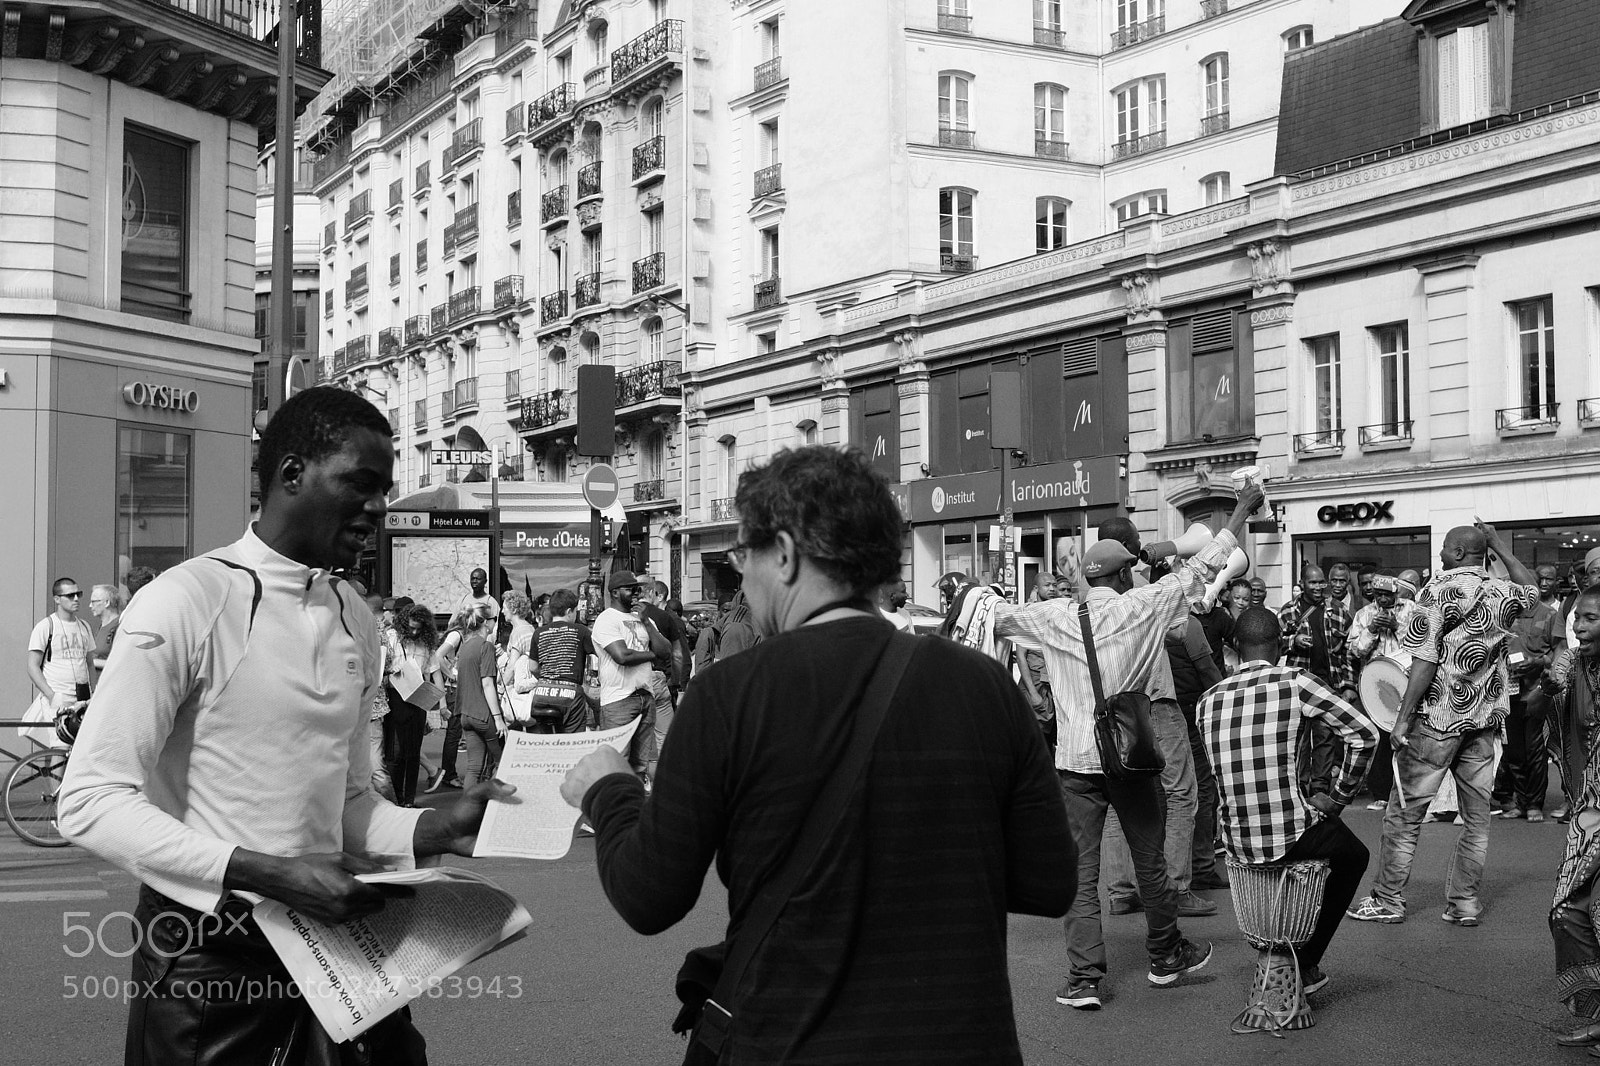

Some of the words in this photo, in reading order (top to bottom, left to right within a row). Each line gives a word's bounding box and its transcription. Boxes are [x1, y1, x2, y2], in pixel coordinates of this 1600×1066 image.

[128, 381, 199, 413] OYSHO
[432, 450, 492, 464] FLEURS
[945, 490, 976, 505] Institut
[1317, 500, 1394, 523] GEOX
[433, 518, 453, 526] Hôtel
[454, 518, 463, 526] de
[464, 518, 481, 526] Ville
[516, 531, 549, 547] Porte
[516, 737, 527, 746] la
[552, 738, 571, 746] des
[286, 909, 331, 971] sans-papiers
[359, 941, 391, 986] NOUVELLE
[327, 970, 342, 989] des
[389, 985, 399, 998] LA
[339, 988, 355, 1012] voix
[352, 1010, 363, 1025] la
